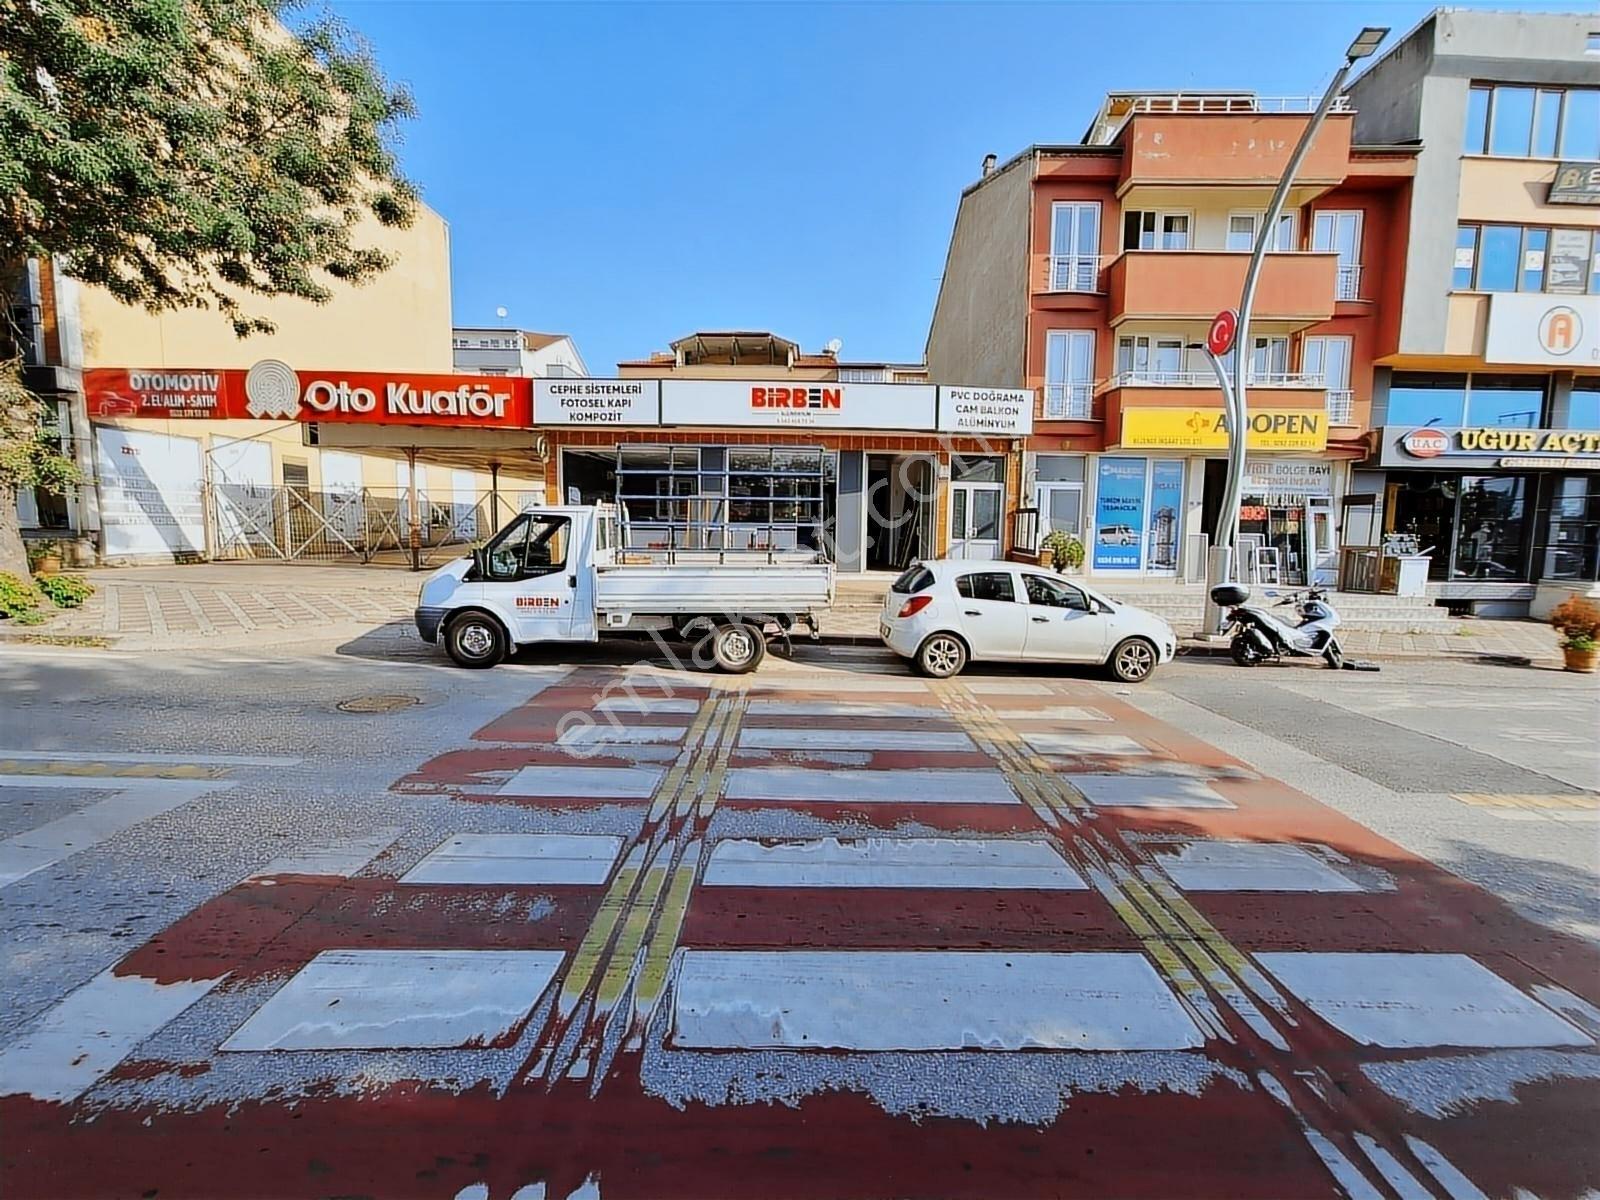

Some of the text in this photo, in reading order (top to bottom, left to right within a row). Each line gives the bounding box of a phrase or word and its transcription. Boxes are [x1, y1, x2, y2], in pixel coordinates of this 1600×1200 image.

[129, 372, 219, 391] OTOMOTİV
[550, 383, 642, 394] CEPHE SİSTEMLERİ
[304, 380, 511, 418] Oto Kuaför
[950, 391, 1024, 402] PVC DOĞRAMA
[560, 399, 631, 408] FOTOSEL KAPI
[569, 410, 622, 422] KOMPOZİT
[956, 405, 1019, 415] CAM BALKON
[957, 416, 1015, 428] ALÜMİNYUM
[1460, 428, 1600, 453] UĞUR AÇT
